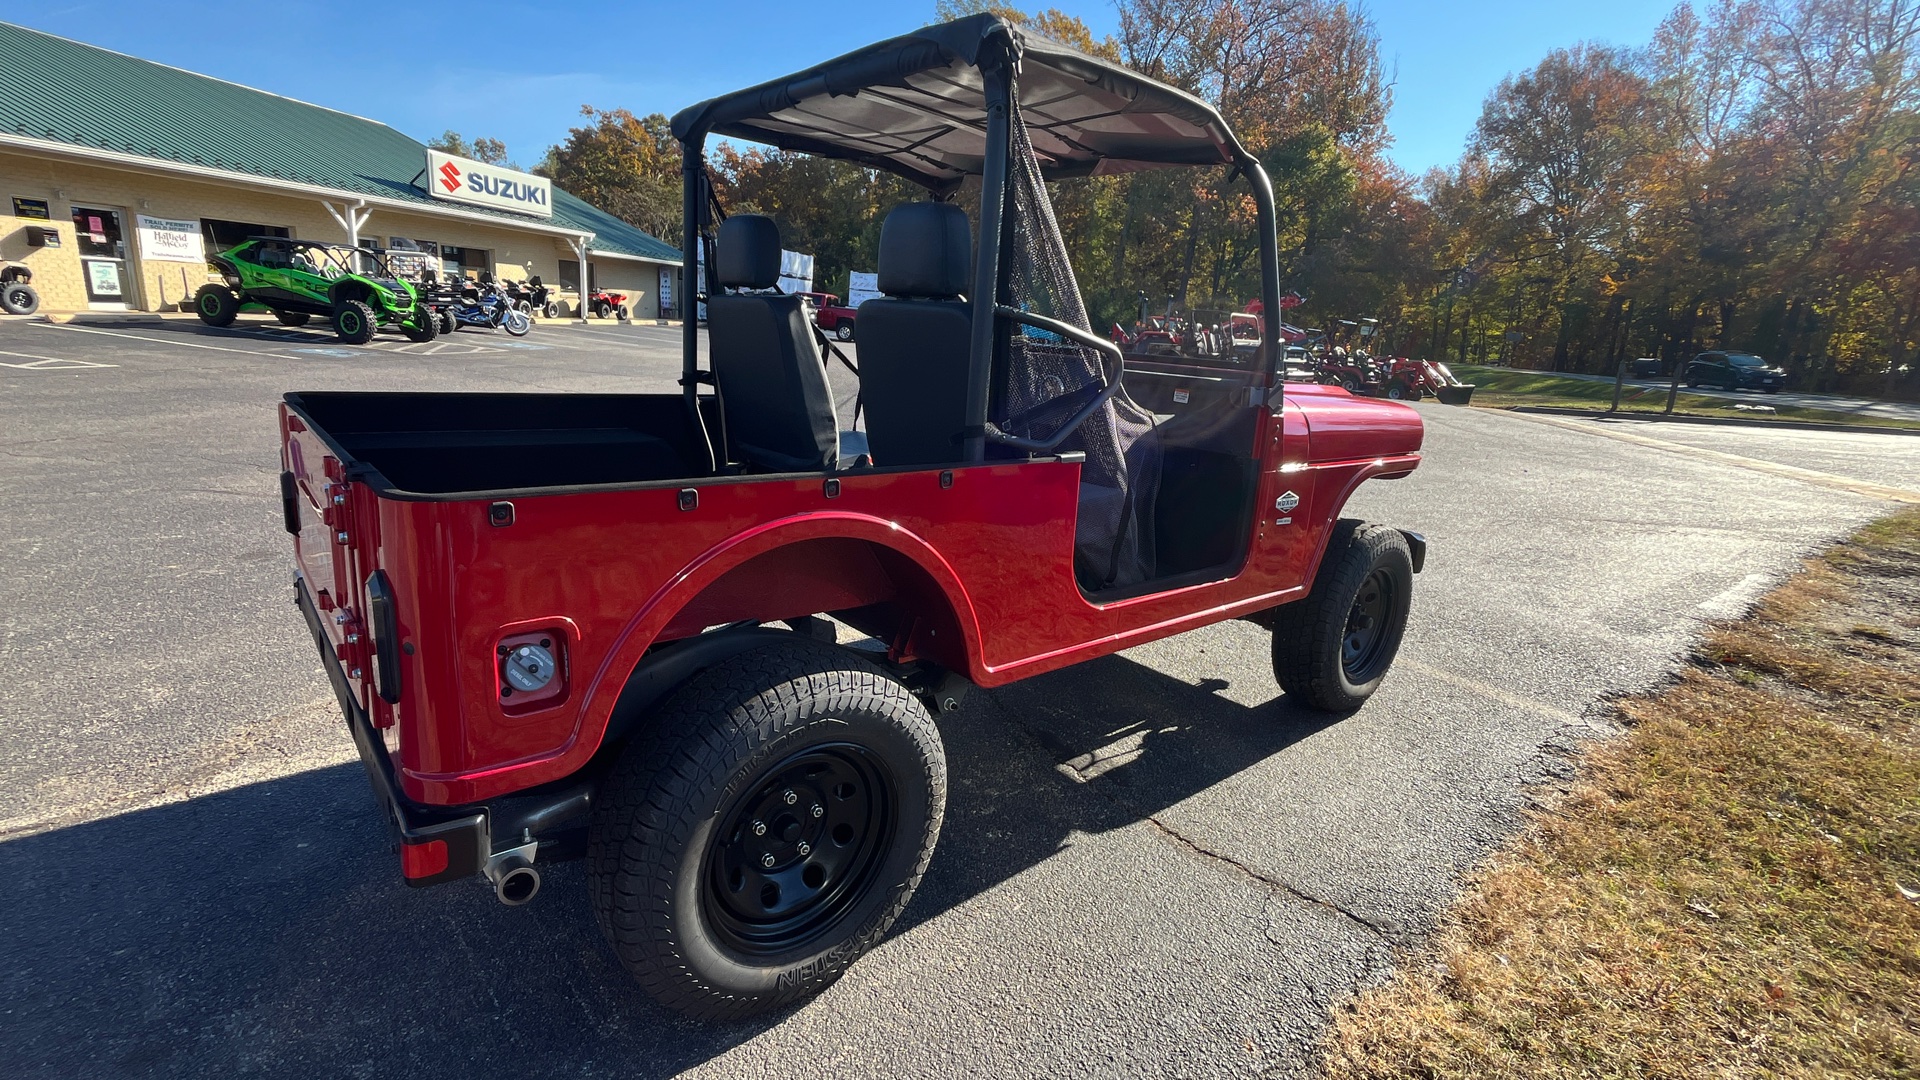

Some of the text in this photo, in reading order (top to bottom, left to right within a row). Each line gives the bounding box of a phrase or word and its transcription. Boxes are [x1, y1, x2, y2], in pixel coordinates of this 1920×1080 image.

[467, 171, 546, 206] SUZUKI
[144, 218, 194, 229] TRAIL PERMITS
[154, 231, 188, 243] Hatfield
